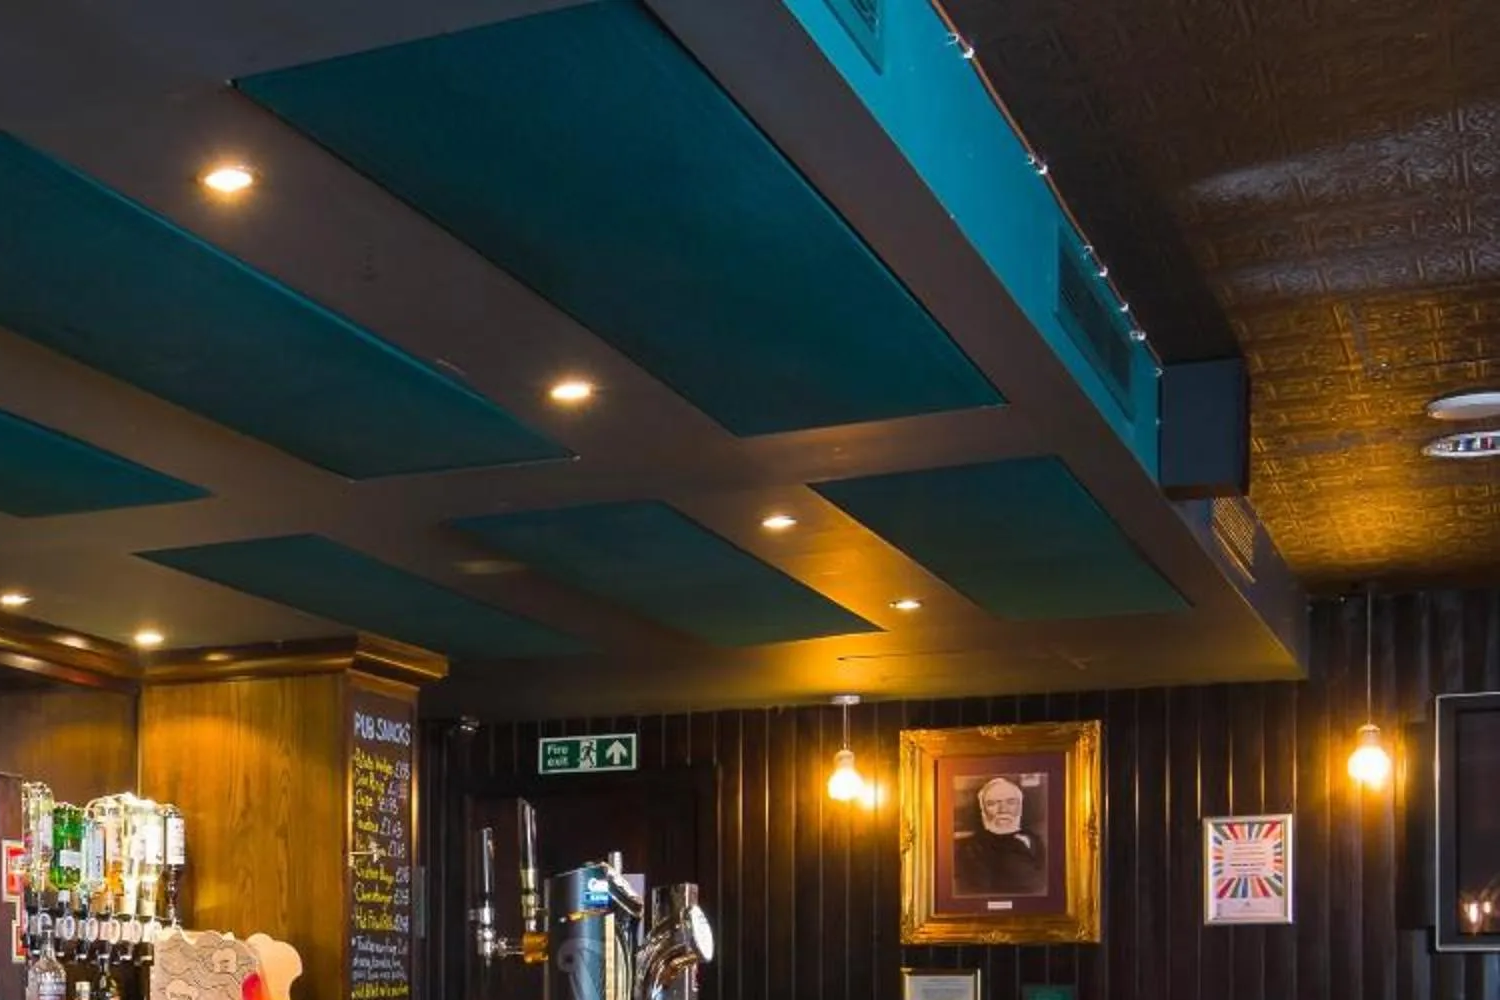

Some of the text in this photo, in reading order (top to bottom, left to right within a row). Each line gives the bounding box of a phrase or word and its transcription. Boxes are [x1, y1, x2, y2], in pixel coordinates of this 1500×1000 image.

[353, 711, 375, 741] PUB
[546, 743, 569, 756] Fire
[546, 756, 570, 768] exit
